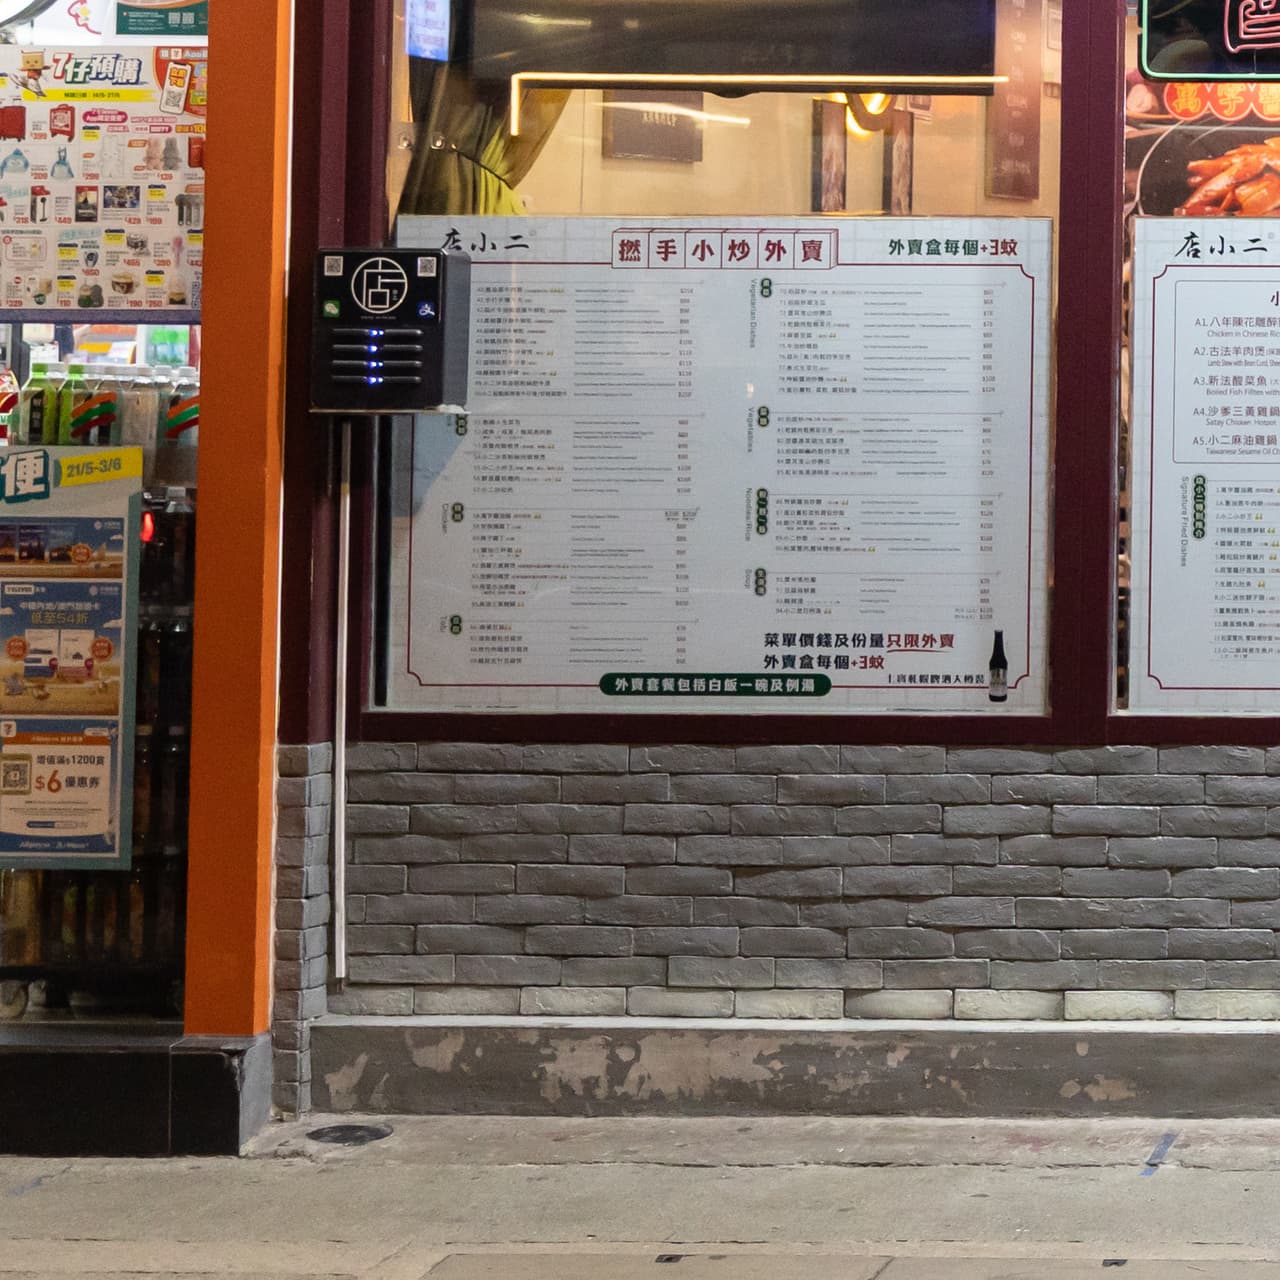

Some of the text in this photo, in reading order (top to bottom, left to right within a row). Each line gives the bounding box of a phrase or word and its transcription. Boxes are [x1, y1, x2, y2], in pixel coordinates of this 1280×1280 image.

[441, 228, 530, 253] 店小二
[1174, 231, 1269, 259] 店小二
[66, 457, 122, 478] 21/5-3/6
[764, 632, 955, 649] 菜單價錢及份量只限外賣
